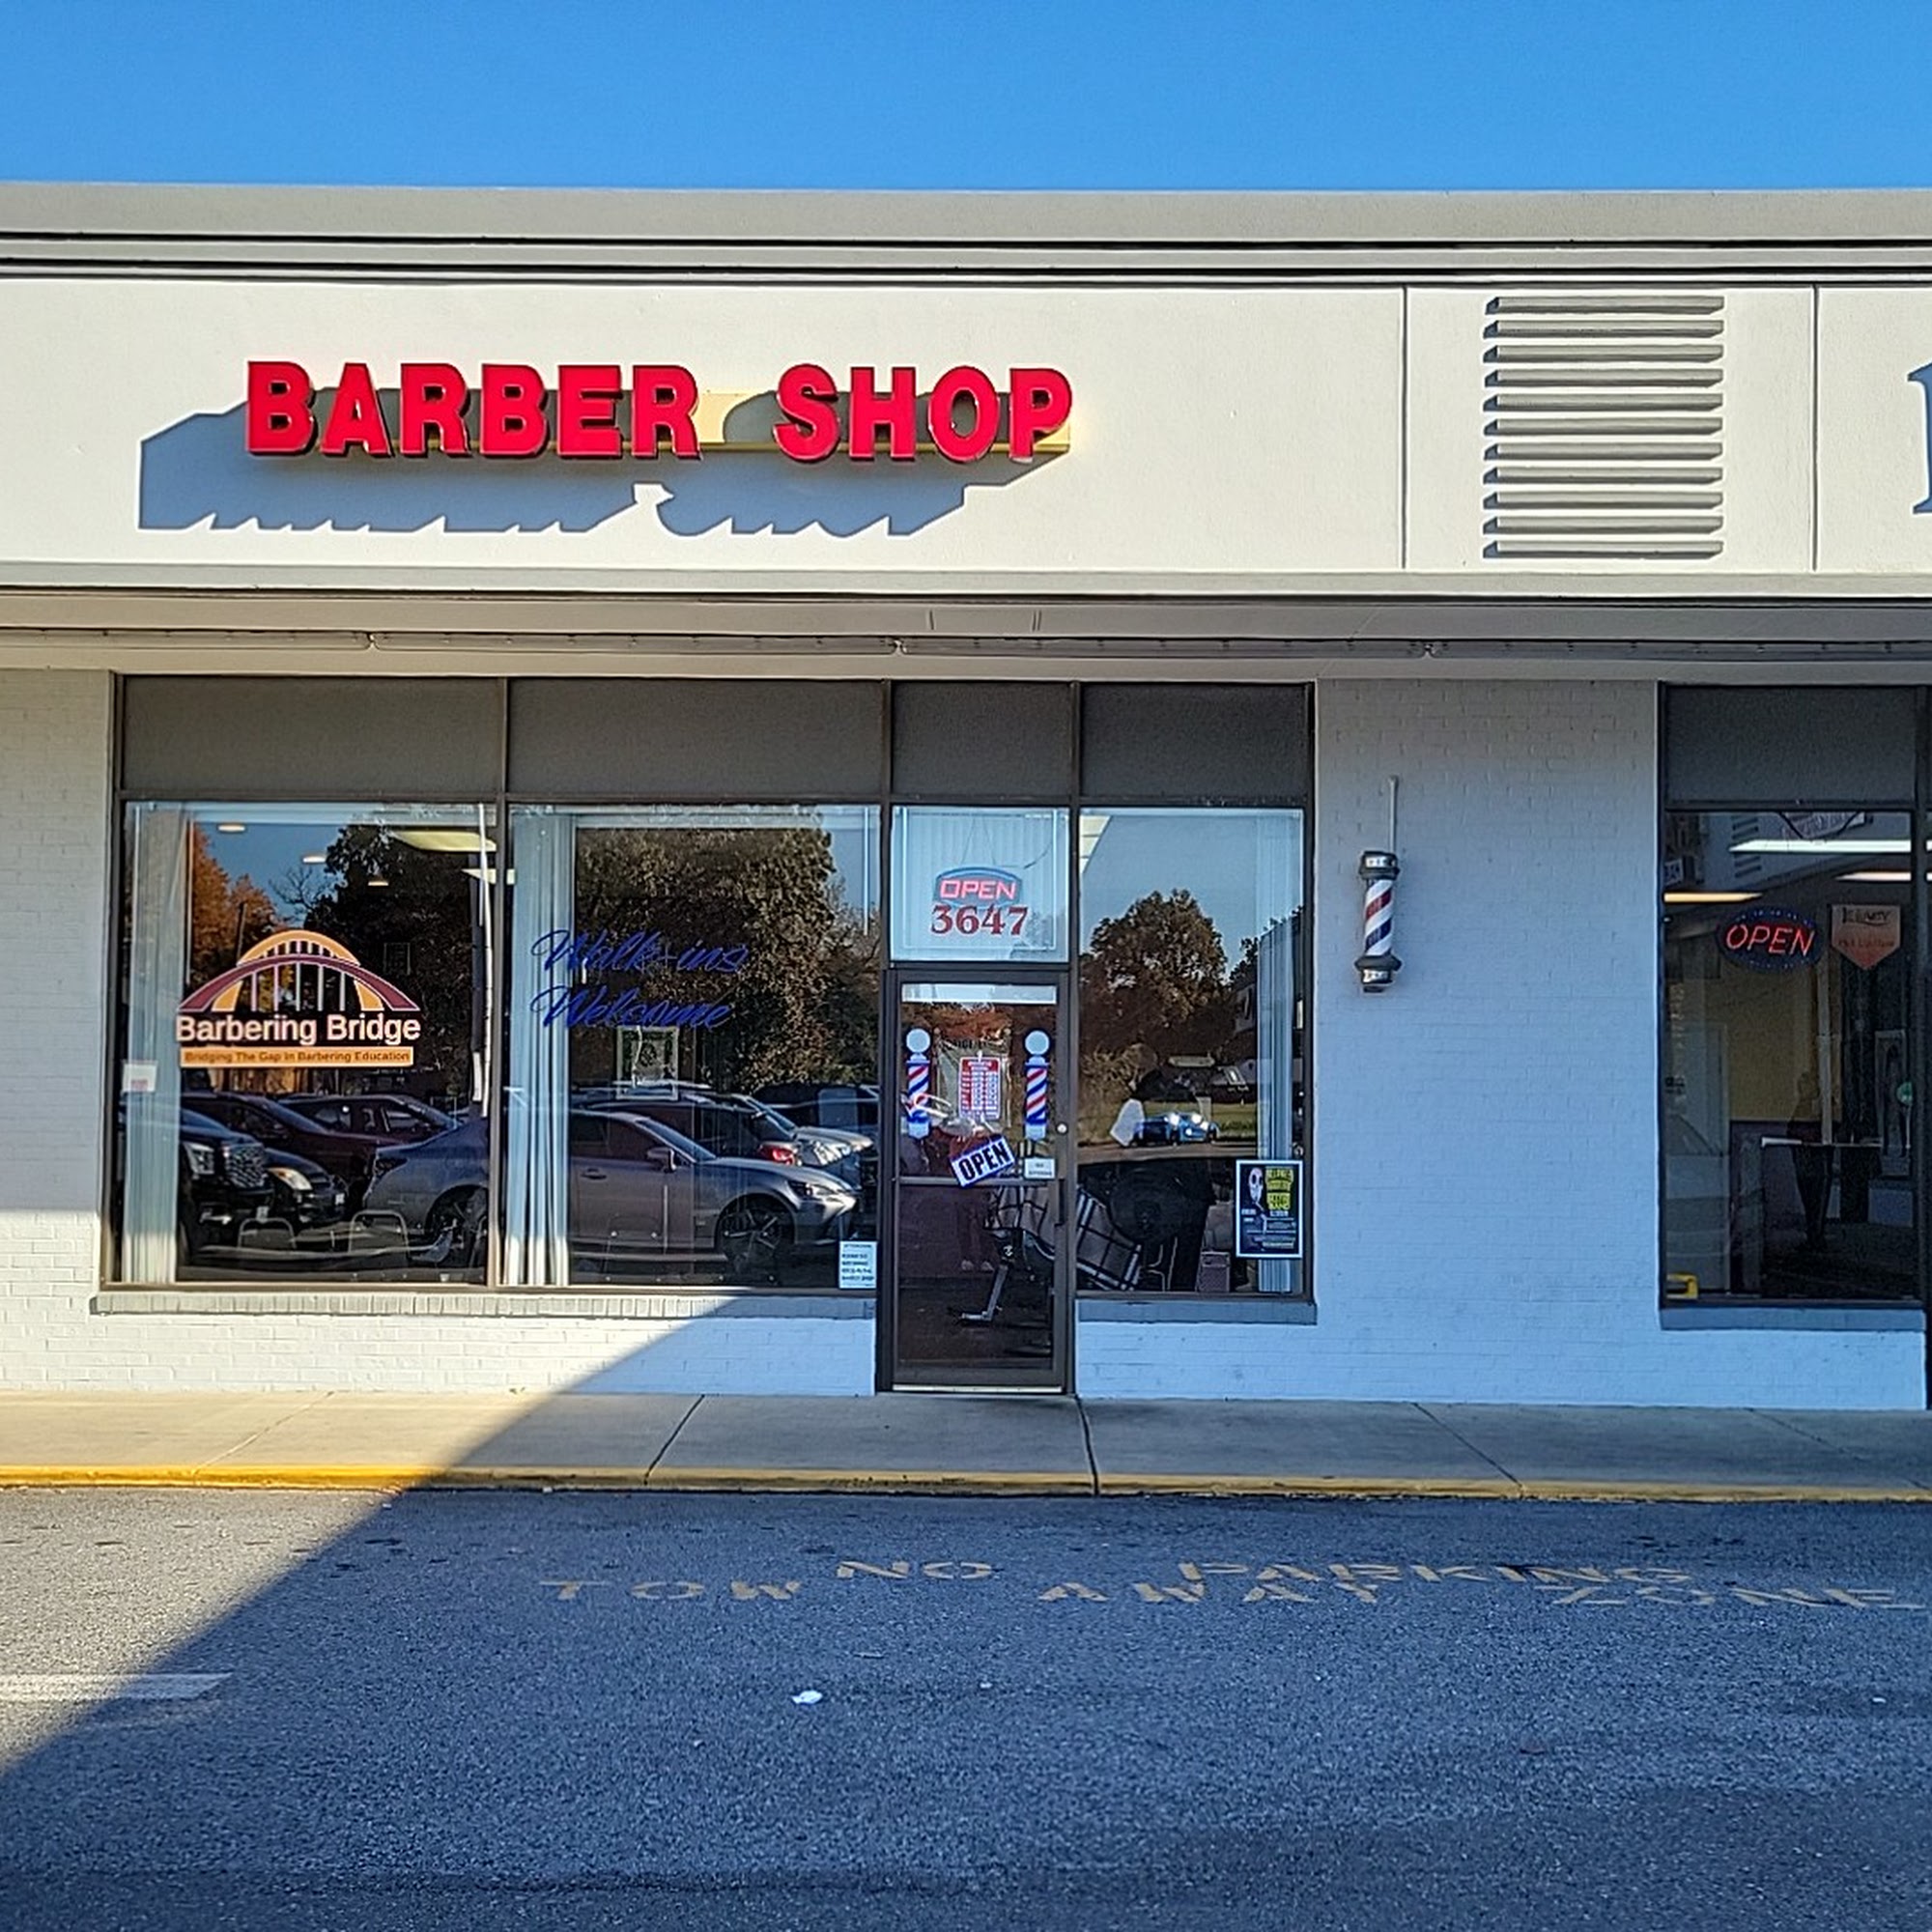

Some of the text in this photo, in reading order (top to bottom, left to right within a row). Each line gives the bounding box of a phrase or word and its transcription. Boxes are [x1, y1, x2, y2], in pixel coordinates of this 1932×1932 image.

[245, 361, 1073, 463] BARBER SHOP
[939, 880, 1016, 899] OPEN
[930, 904, 1029, 936] 3647
[1725, 923, 1815, 956] OPEN
[529, 985, 732, 1029] Welcome
[176, 1014, 421, 1045] Barbering Bridge
[185, 1052, 233, 1064] Bridging
[236, 1052, 257, 1062] The
[259, 1052, 282, 1064] Gap
[298, 1051, 352, 1064] Barbering
[355, 1051, 411, 1062] Education
[958, 1142, 1010, 1180] OPEN
[837, 1561, 1692, 1582] NO PARKING
[539, 1580, 801, 1600] TOW
[1038, 1582, 1378, 1604] AWAY
